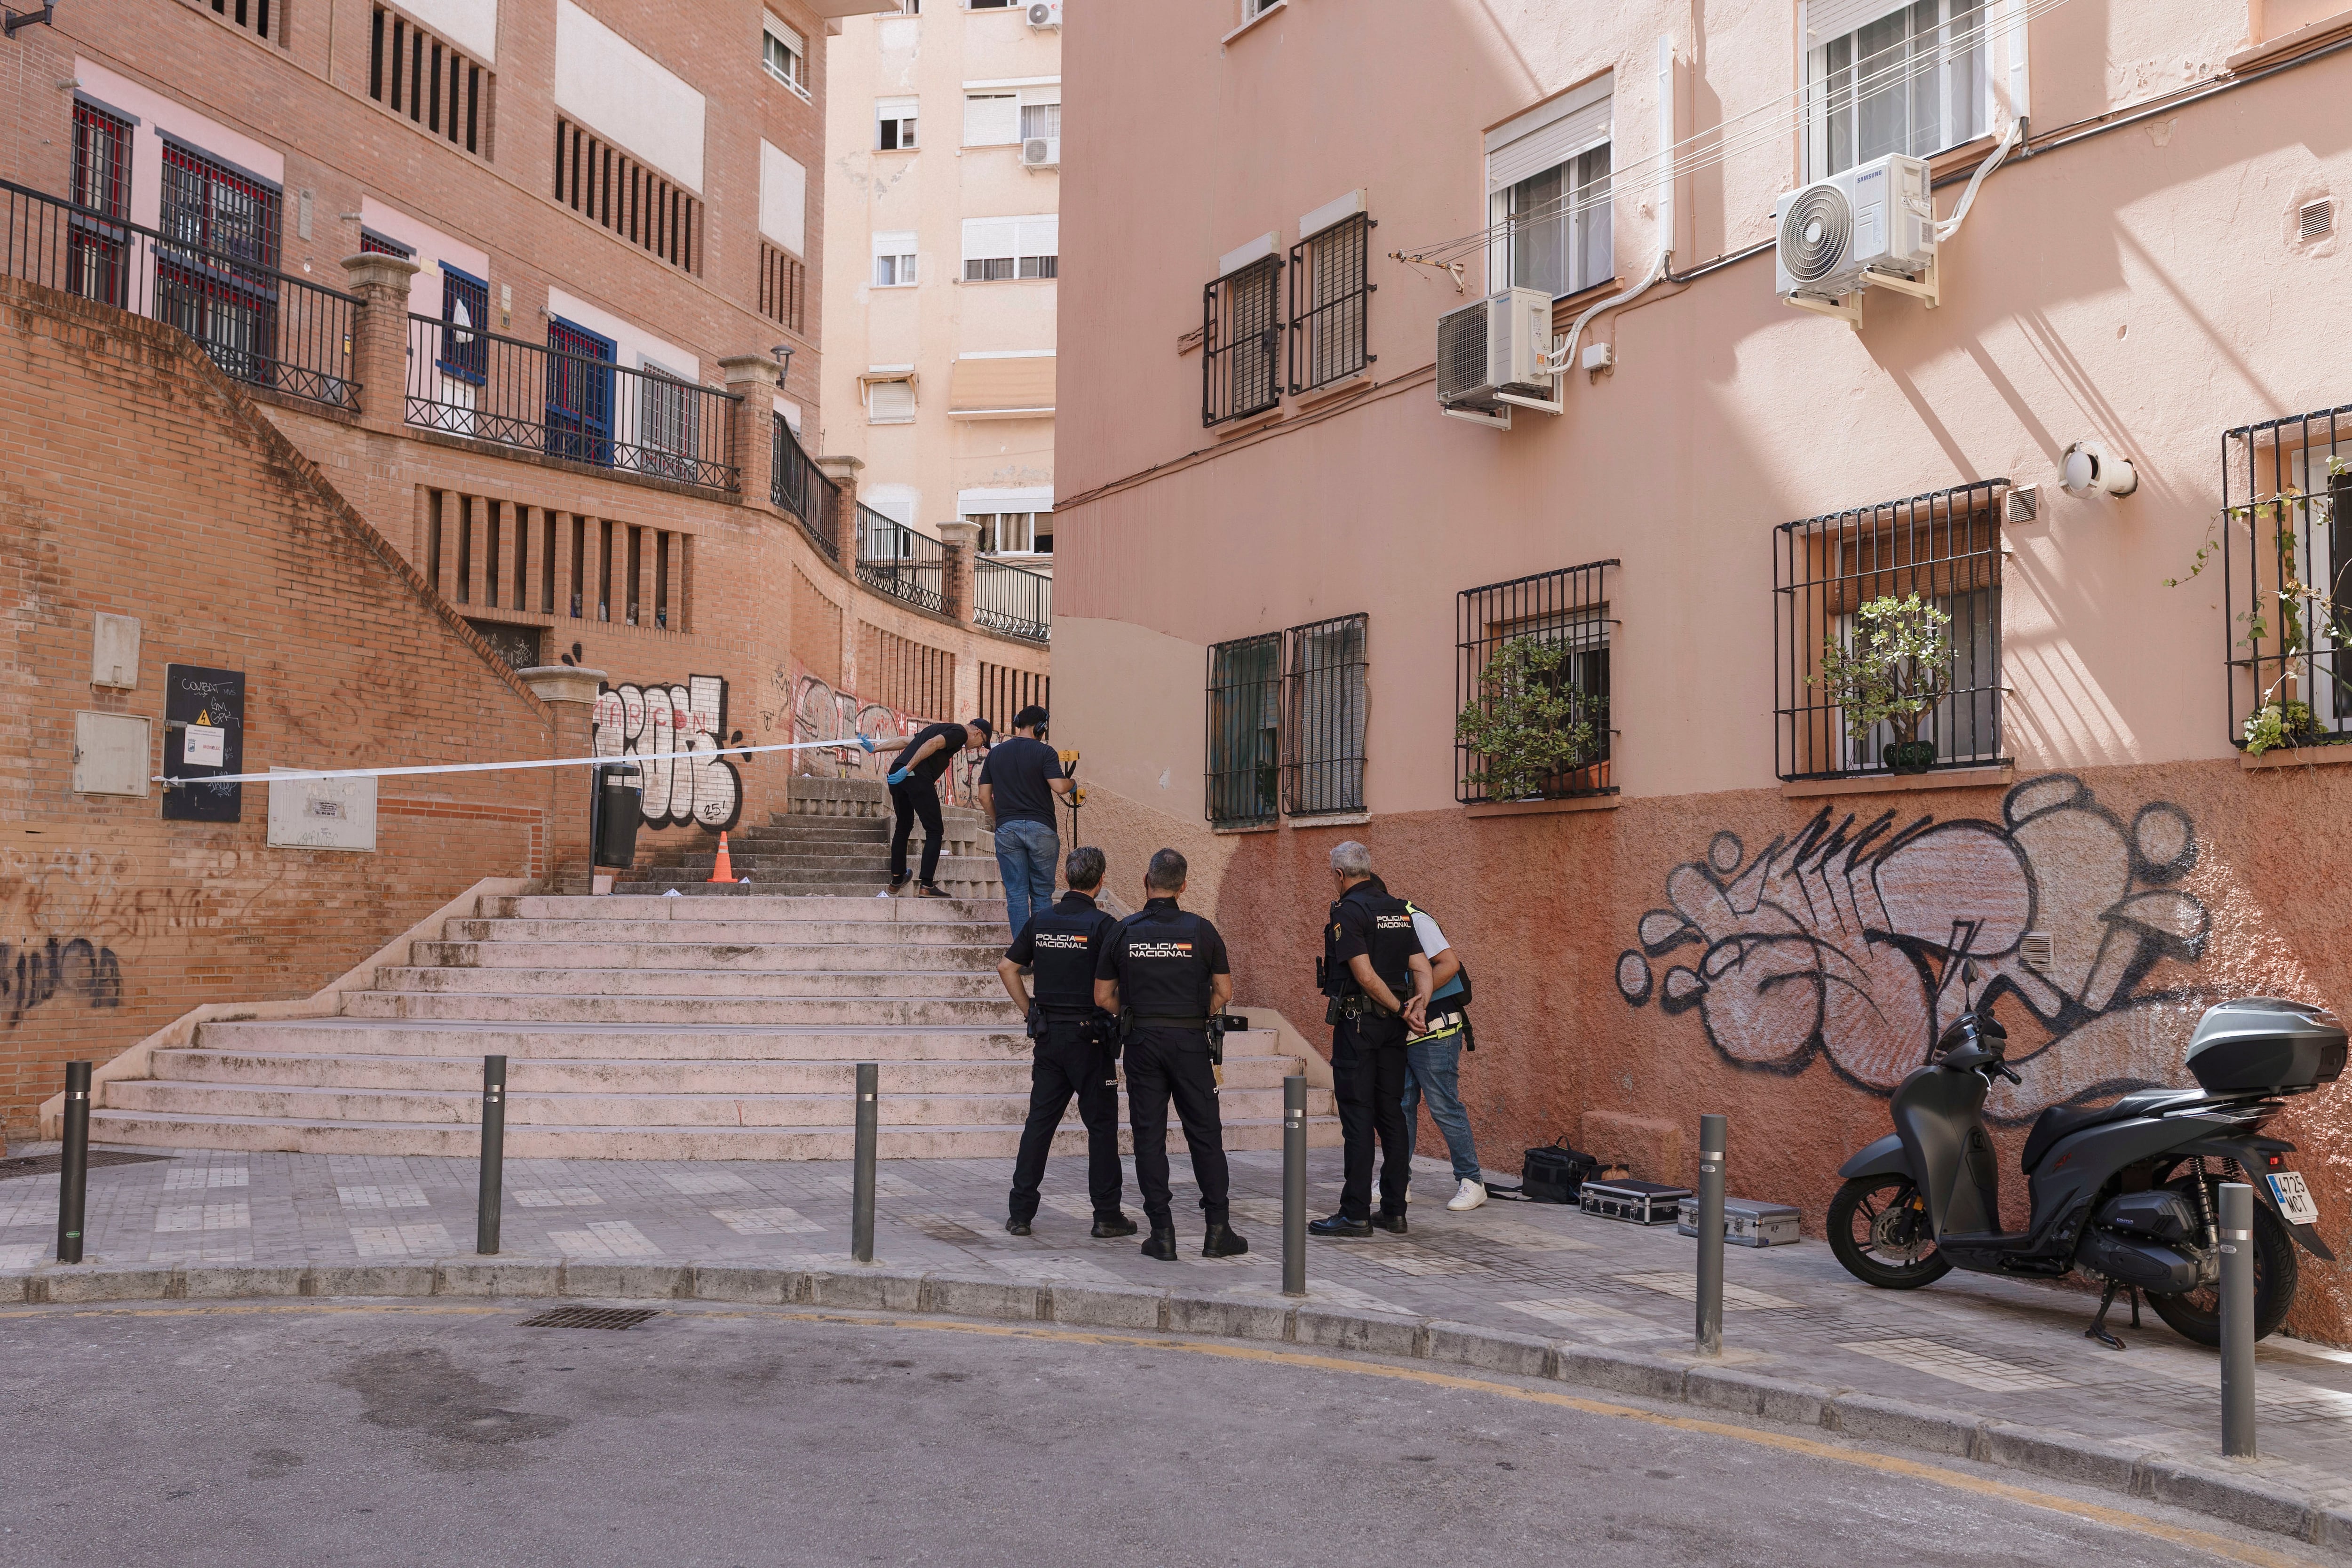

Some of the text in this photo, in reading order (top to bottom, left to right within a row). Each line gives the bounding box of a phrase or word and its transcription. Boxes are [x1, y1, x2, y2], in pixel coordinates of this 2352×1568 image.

[1857, 170, 1882, 183] SAMSUNG
[182, 678, 233, 693] COMBAT
[1036, 941, 1088, 949] NACIONAL
[2279, 1176, 2305, 1194] 4725
[2285, 1195, 2307, 1213] MCT
